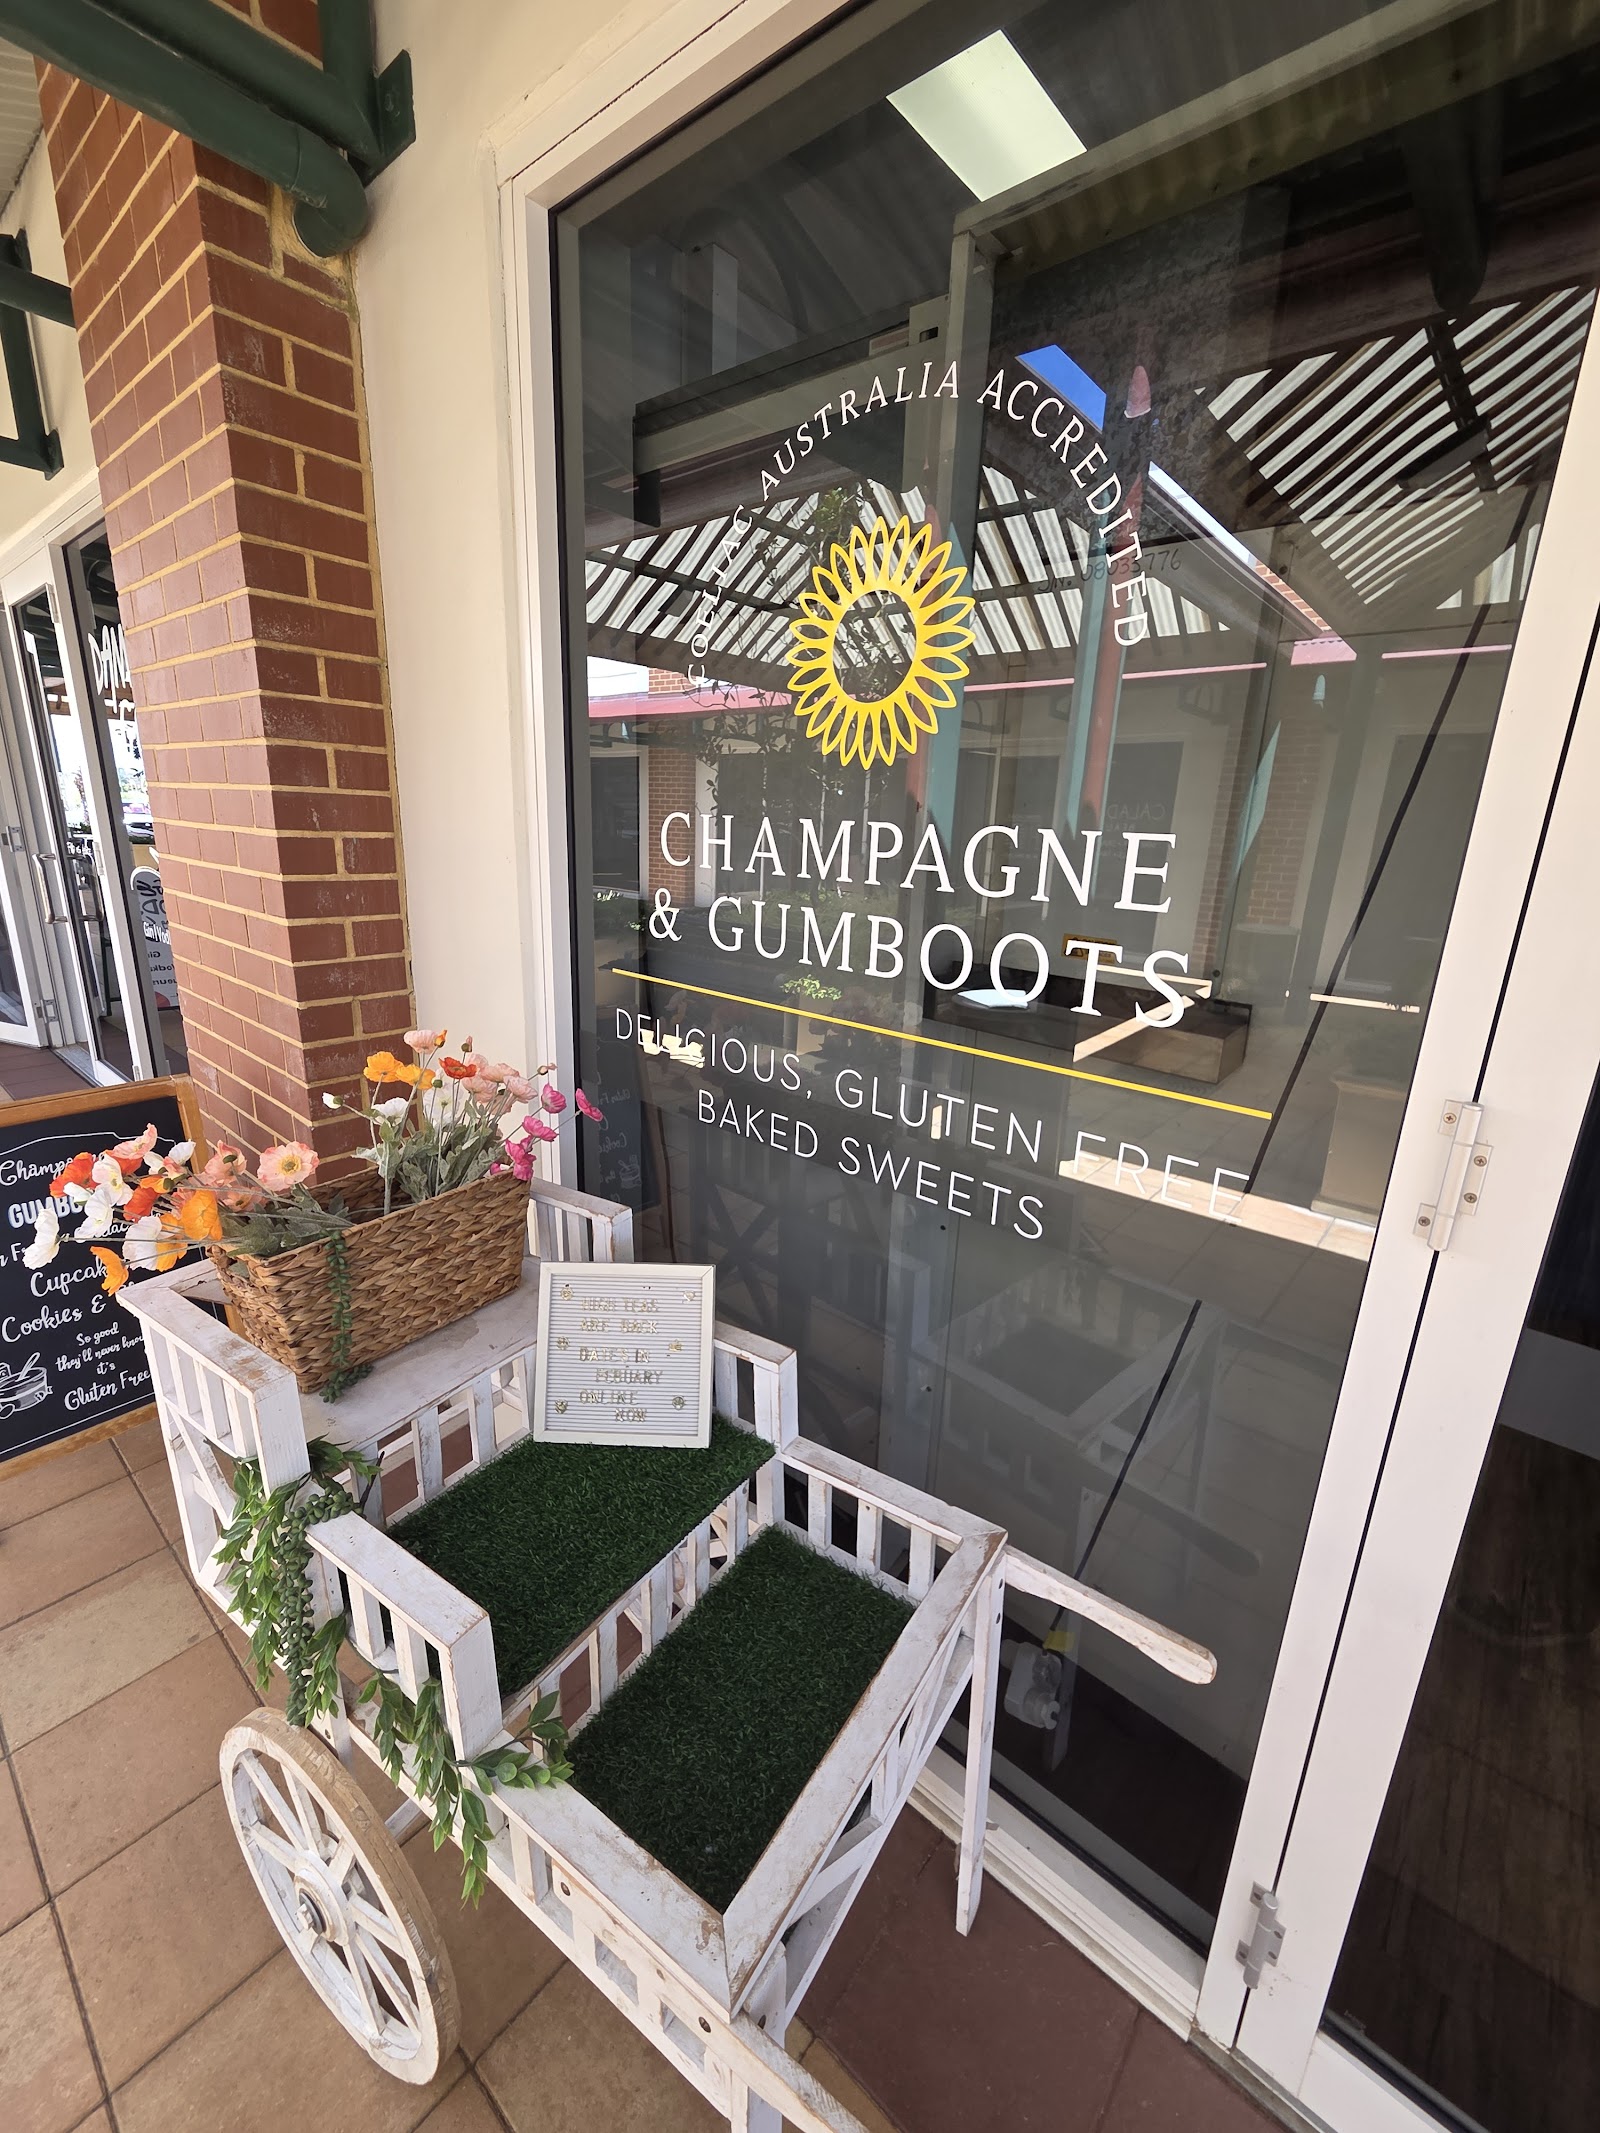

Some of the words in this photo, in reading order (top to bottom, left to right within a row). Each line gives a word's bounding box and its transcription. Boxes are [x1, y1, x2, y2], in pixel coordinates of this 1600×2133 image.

[687, 504, 753, 688] COELIAC
[759, 361, 960, 502] AUSTRALIA
[977, 369, 1150, 647] ACCREDITED
[660, 811, 1178, 914] CHAMPAGNE
[648, 887, 682, 942] &
[708, 895, 1191, 1029] GUMBOOTS
[616, 1007, 813, 1100] DELICIOUS,
[834, 1069, 1043, 1164] GLUTEN
[1074, 1132, 1252, 1226] FREE
[697, 1088, 818, 1160] BAKED
[838, 1136, 1045, 1241] SWEETS
[2, 1305, 82, 1342] Cookies
[91, 1294, 107, 1314] &
[76, 1333, 92, 1346] So
[94, 1322, 119, 1345] good
[581, 1317, 609, 1333] ARE
[620, 1319, 658, 1334] BACK
[55, 1347, 92, 1372] they'll
[95, 1342, 121, 1360] never
[96, 1362, 116, 1375] it's
[579, 1346, 629, 1362] DATES
[635, 1349, 650, 1363] IN
[64, 1381, 118, 1411] Gluten
[120, 1369, 151, 1390] Free
[579, 1388, 639, 1405] ONLINE
[615, 1407, 647, 1422] NOW
